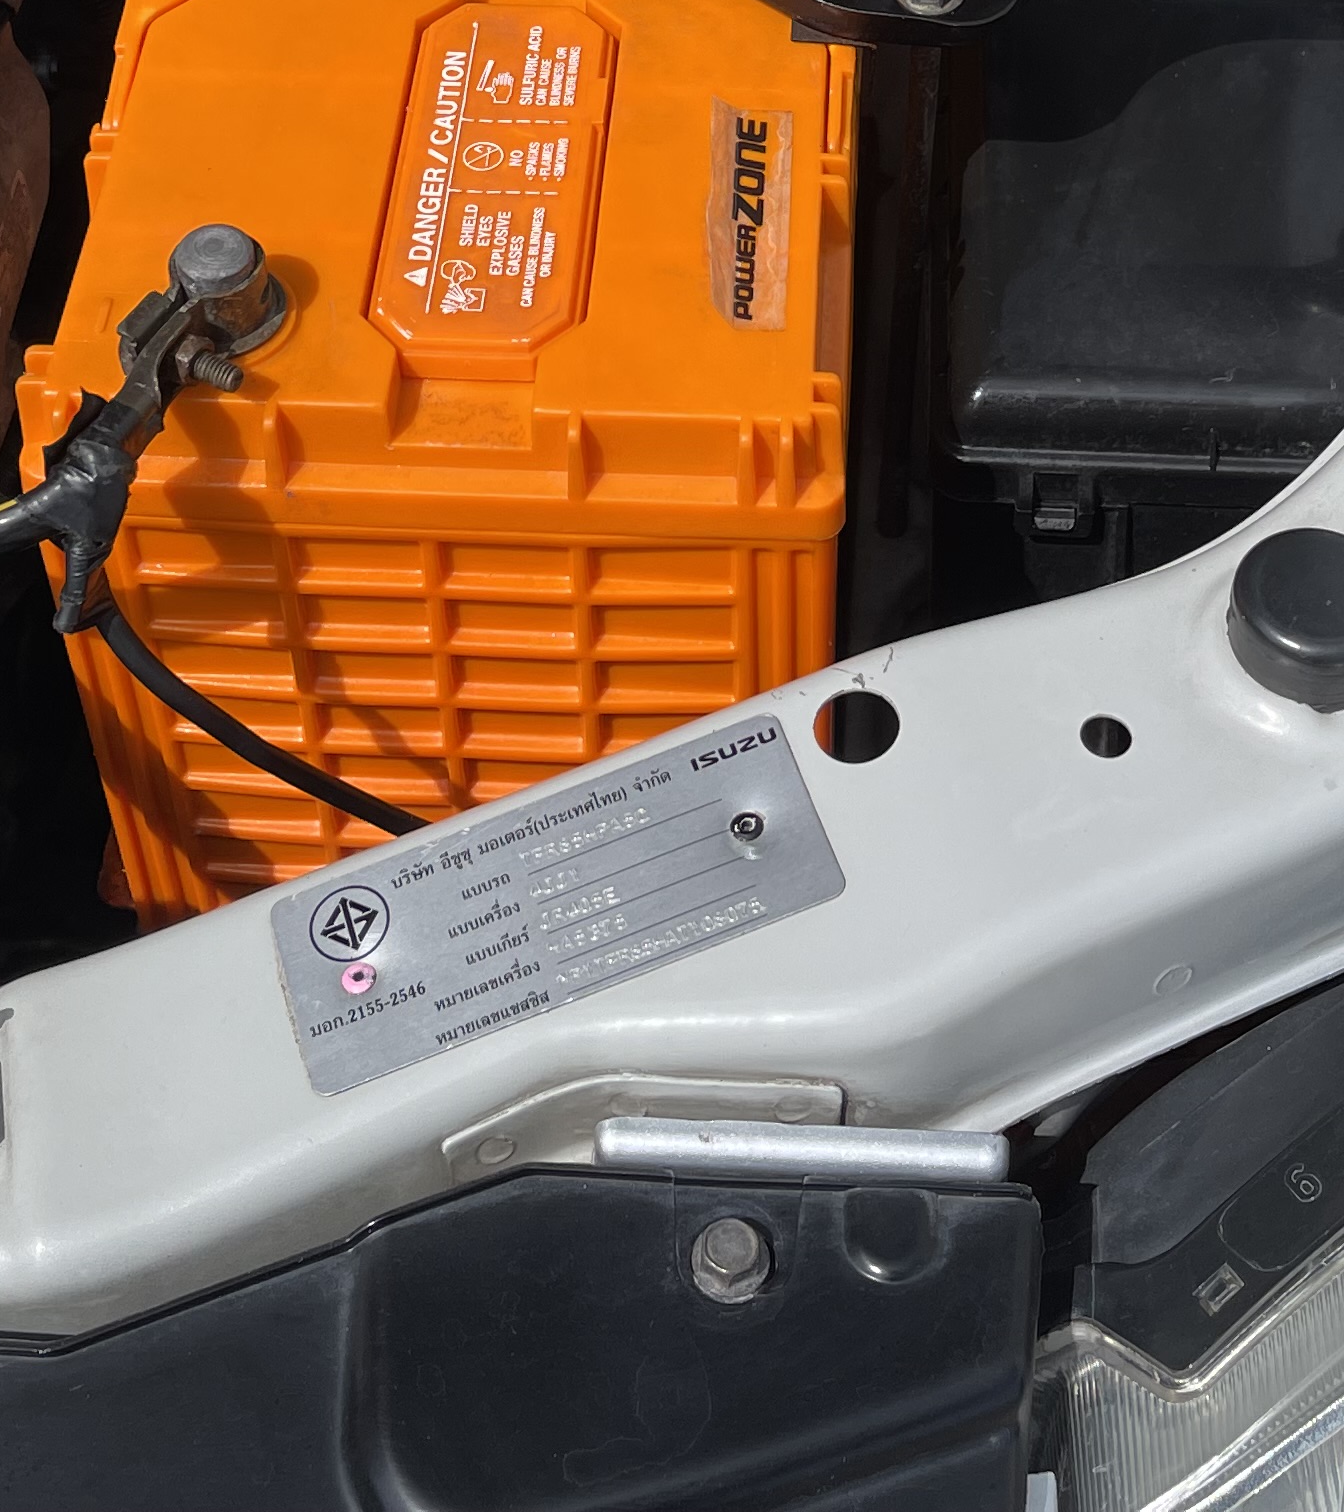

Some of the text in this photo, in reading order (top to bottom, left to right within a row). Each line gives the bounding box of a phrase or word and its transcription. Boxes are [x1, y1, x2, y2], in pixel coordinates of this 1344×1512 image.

[519, 25, 543, 106] SULFURIC ACID
[535, 58, 553, 106] CAN CAUSE
[408, 167, 447, 261] DANGER
[429, 51, 467, 146] CAUTION
[509, 149, 524, 167] NO
[459, 204, 478, 247] SHIELD
[476, 215, 494, 247] EYES
[489, 210, 512, 276] EXPLOSIVE
[505, 235, 525, 276] GASES
[520, 287, 534, 308] CAN
[690, 726, 778, 772] ISUZU
[390, 863, 435, 889] บริษัท
[633, 768, 672, 793] จำกัด
[461, 872, 511, 901] แบบรถ
[448, 899, 521, 939] แบบเครื่อง
[465, 923, 531, 966] แบบเกียร์
[434, 958, 541, 1012] หมายเลขเครื่อง
[309, 981, 426, 1038] มอก.2155-2546
